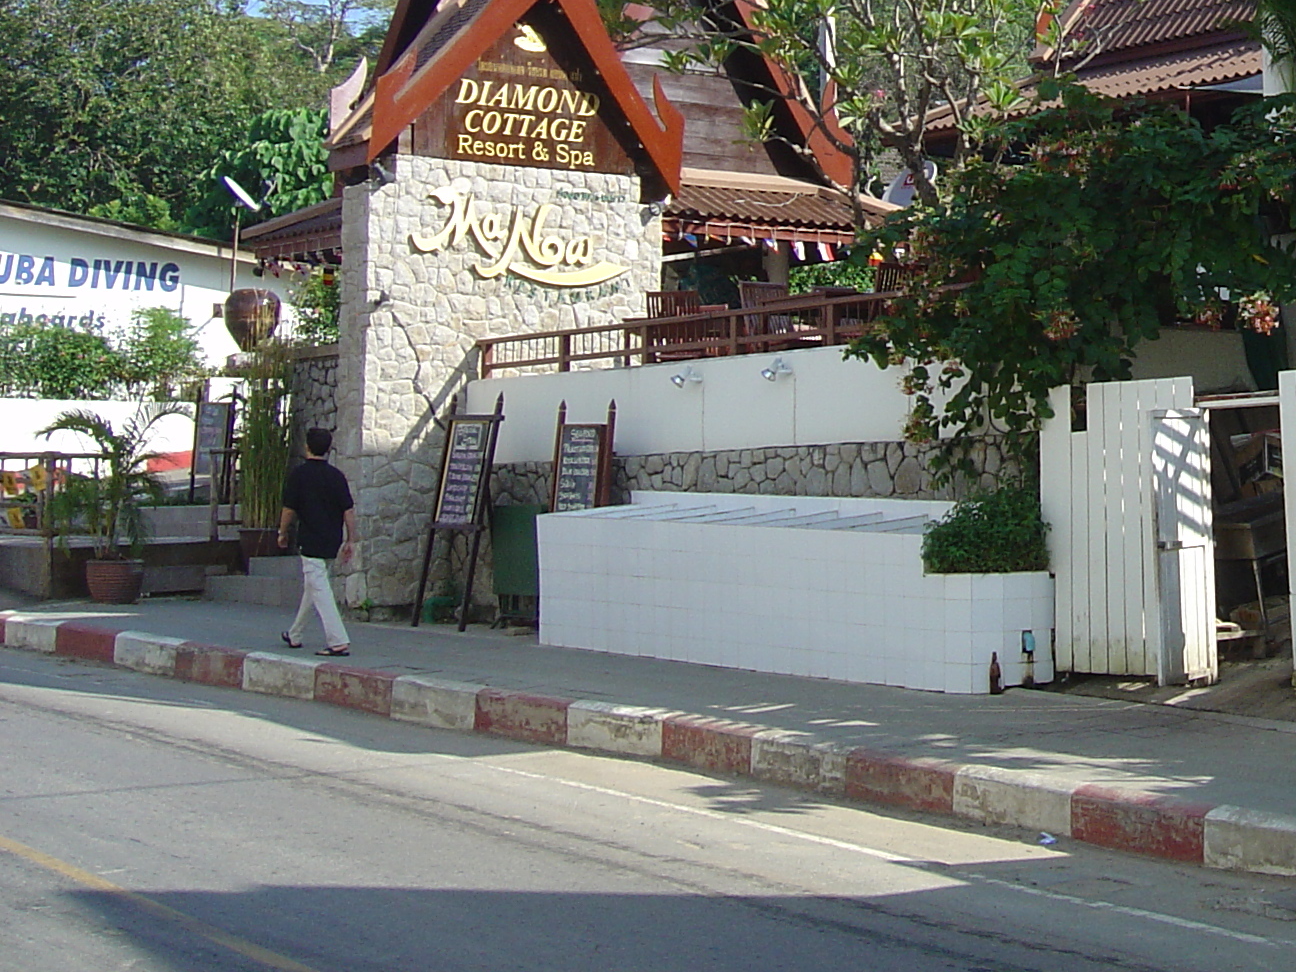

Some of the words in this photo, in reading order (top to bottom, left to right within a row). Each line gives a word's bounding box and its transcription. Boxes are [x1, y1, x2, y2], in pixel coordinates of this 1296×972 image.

[455, 78, 600, 117] DIAMOND
[465, 109, 587, 143] COTTAGE
[457, 134, 526, 159] Resort
[532, 141, 550, 161] &
[556, 144, 596, 169] Spa
[68, 257, 181, 292] DIVING
